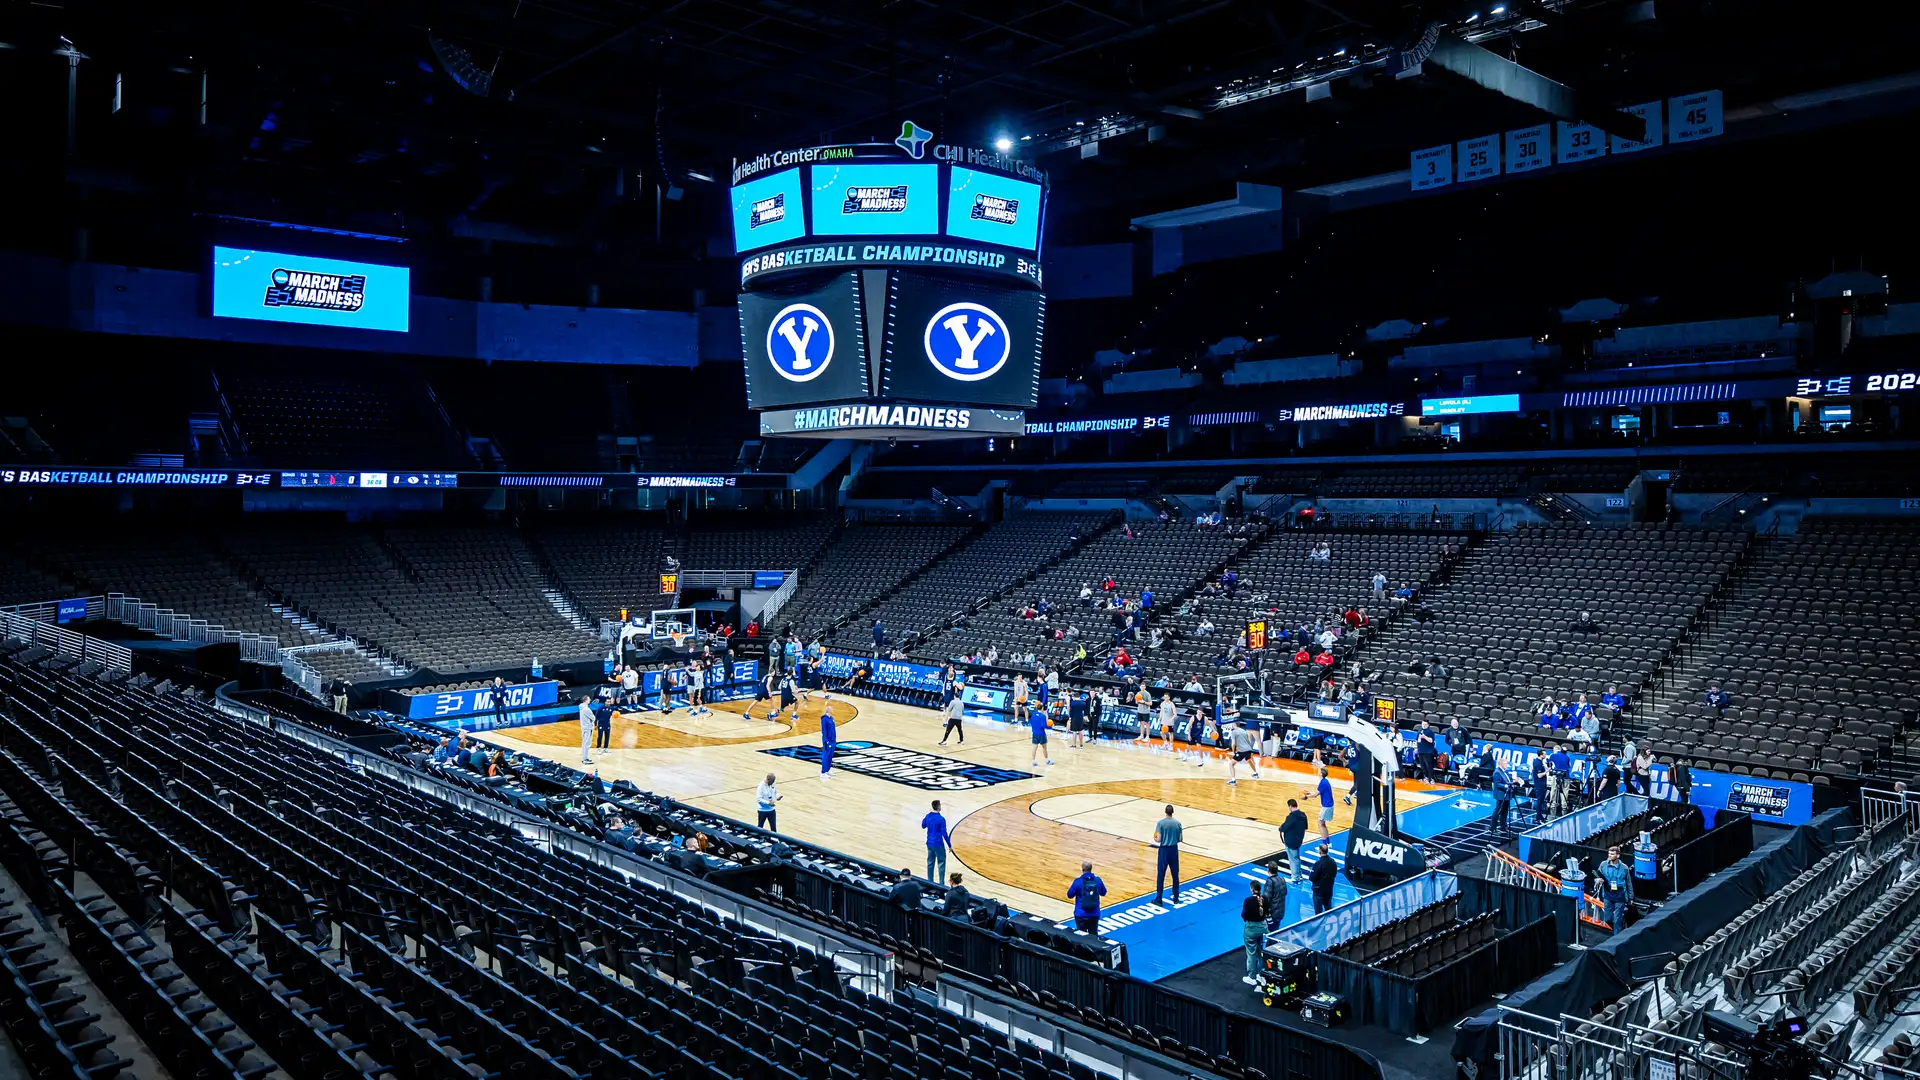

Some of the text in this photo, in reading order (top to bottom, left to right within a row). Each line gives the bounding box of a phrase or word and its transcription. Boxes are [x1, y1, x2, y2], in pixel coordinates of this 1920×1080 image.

[1686, 108, 1707, 125] 45
[1571, 131, 1591, 147] 33
[1519, 142, 1537, 158] 30
[742, 153, 771, 179] Health
[773, 148, 820, 167] Center
[823, 148, 854, 159] OMAHA
[933, 144, 1043, 183] CHI Health Center
[1470, 151, 1487, 167] 25
[1427, 162, 1436, 175] 3
[857, 188, 890, 198] MARCH
[861, 198, 906, 209] MADNESS
[983, 196, 1008, 211] MARCH
[985, 206, 1017, 222] MADNESS
[743, 245, 1006, 279] EN'S BASKETBALL CHAMPIONSHIP
[288, 272, 340, 291] MARCH
[294, 287, 363, 307] MADNESS
[777, 316, 819, 370] Y
[943, 314, 996, 369] Y
[794, 406, 971, 429] #MARCHMADNESS
[1293, 402, 1388, 421] MARCHMADNESS
[1024, 418, 1138, 434] TBALL CHAMPIONSHIP
[19, 471, 113, 483] BASKETBALL
[116, 472, 229, 485] CHAMPIONSHIP
[649, 476, 724, 487] MARCHMADNESS
[662, 582, 675, 593] 30
[1250, 632, 1263, 649] 30
[473, 687, 534, 711] MRCH
[1379, 708, 1391, 719] 30
[1113, 711, 1136, 726] THE
[1177, 721, 1212, 738] FOR
[853, 746, 977, 772] MARCH
[839, 755, 989, 791] MADNESS
[1741, 785, 1774, 797] MARCH
[1745, 794, 1788, 808] MADNESS
[1352, 837, 1404, 865] NCAA
[1168, 883, 1230, 909] FIRST
